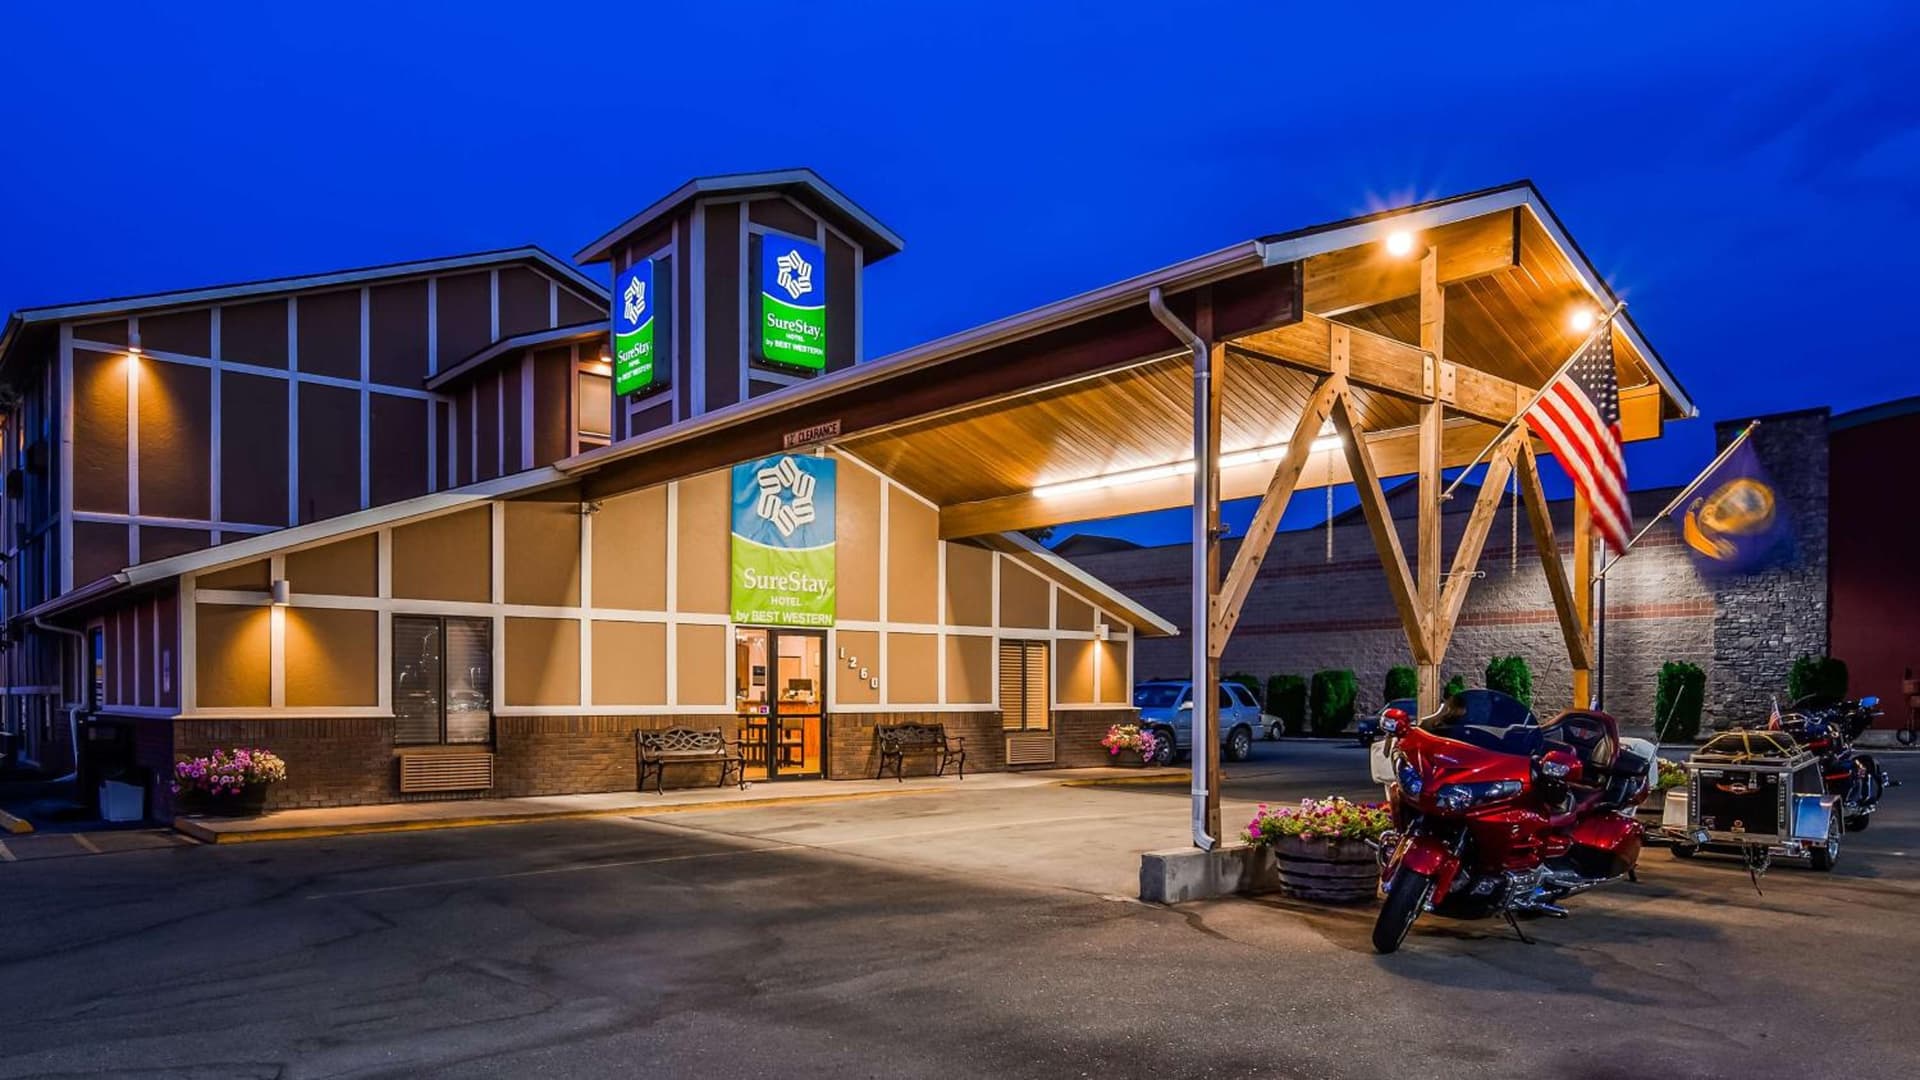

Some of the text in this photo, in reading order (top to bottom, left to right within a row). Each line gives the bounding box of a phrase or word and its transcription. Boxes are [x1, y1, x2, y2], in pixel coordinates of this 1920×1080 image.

[767, 312, 821, 341] SureStay
[798, 422, 838, 444] CLEARANCE
[743, 567, 828, 600] SureStay
[770, 595, 802, 607] HOTEL
[735, 609, 832, 625] by BEST WESTERN
